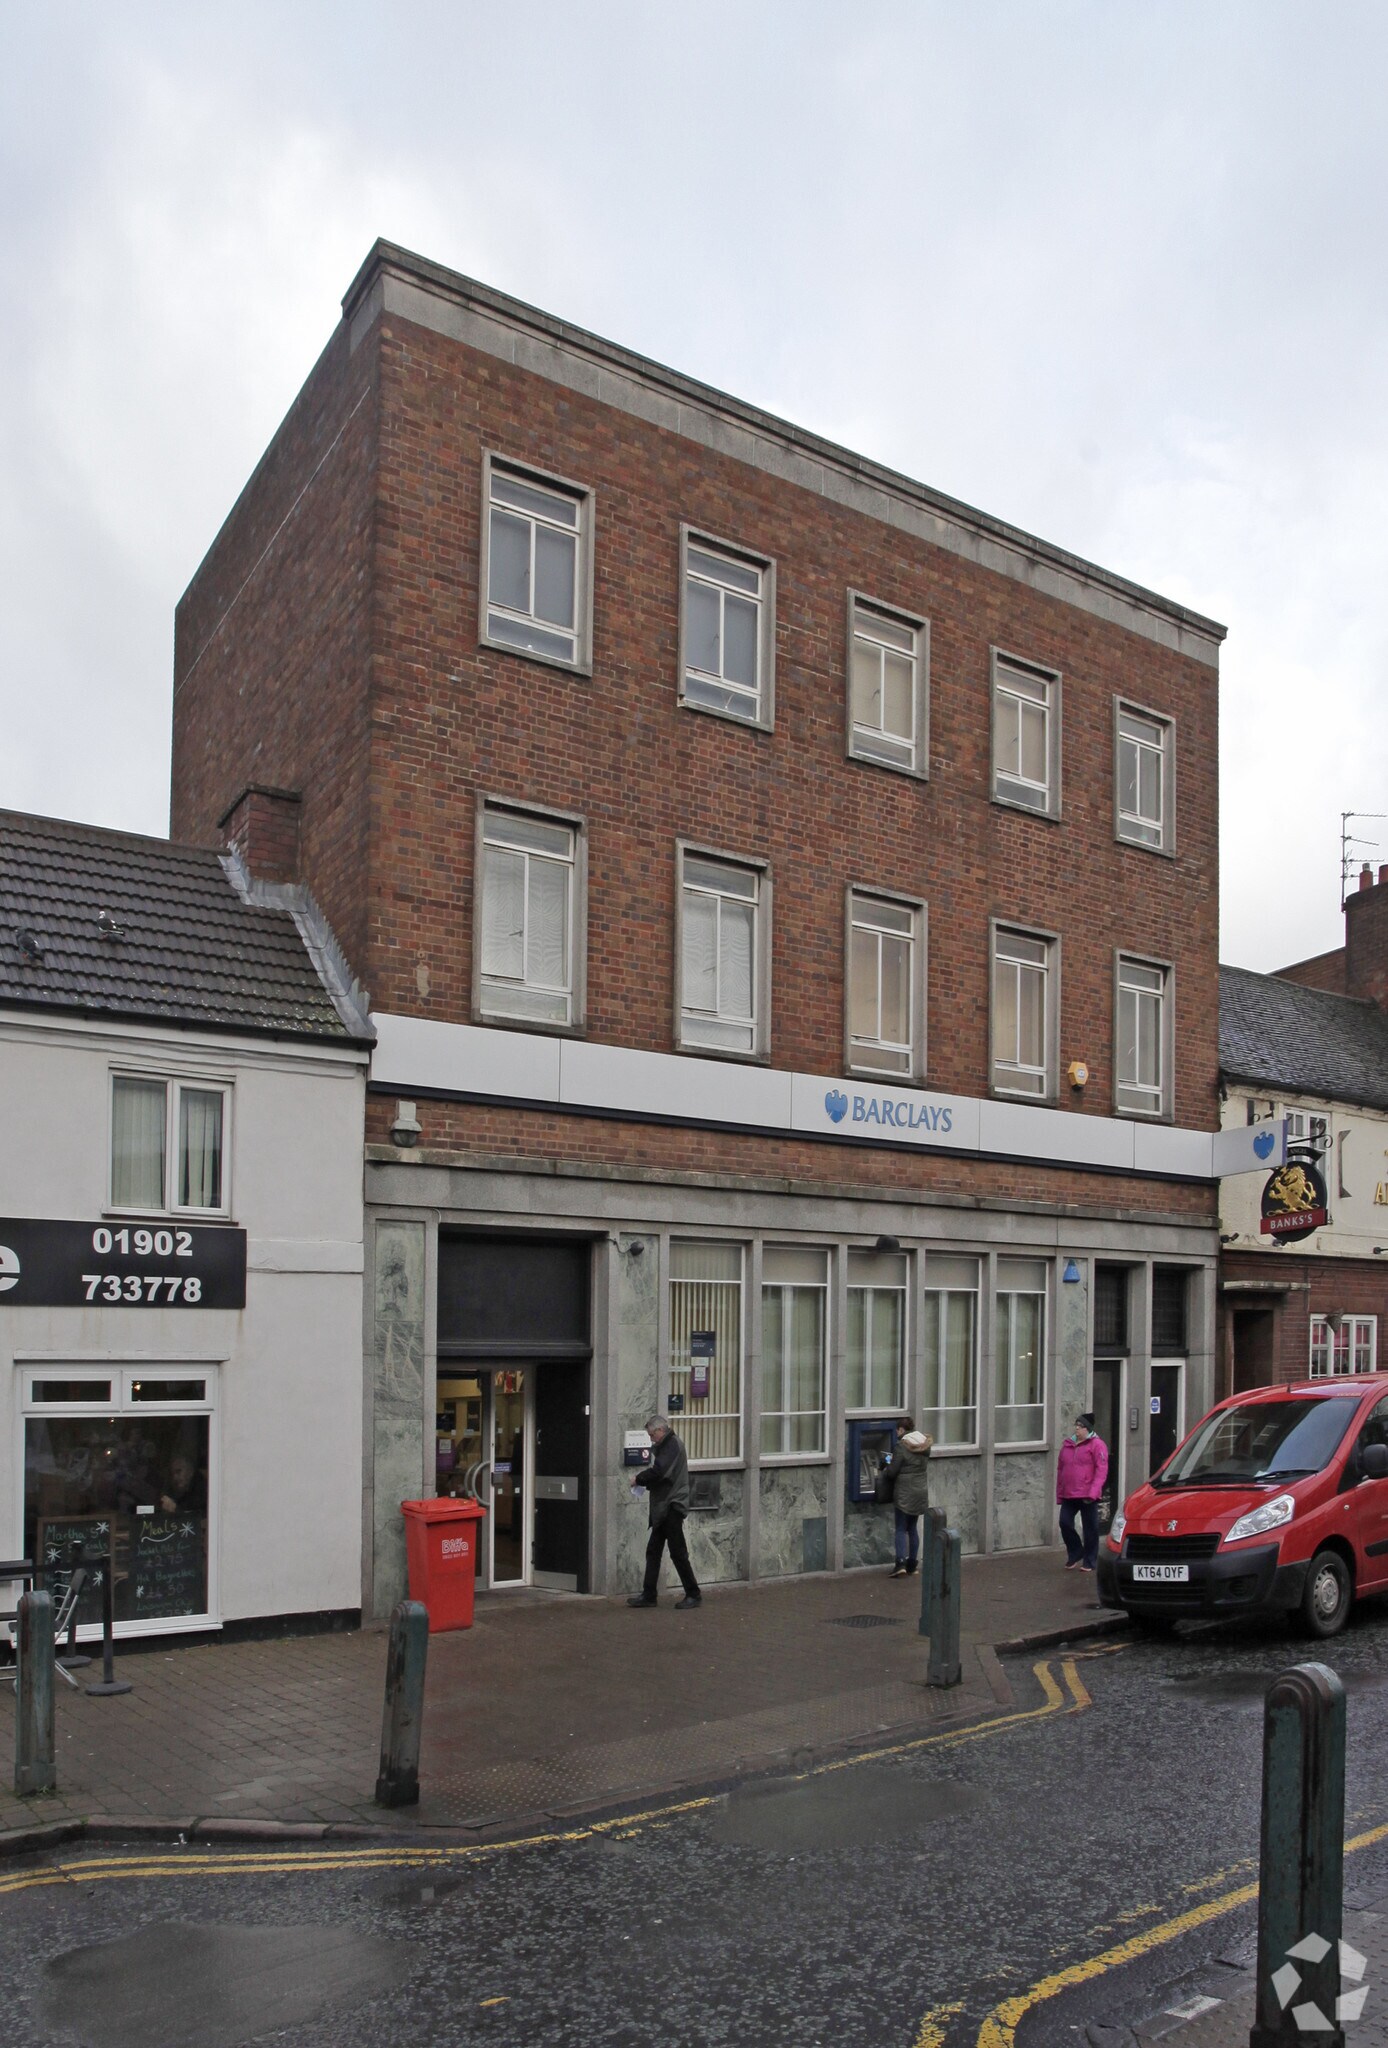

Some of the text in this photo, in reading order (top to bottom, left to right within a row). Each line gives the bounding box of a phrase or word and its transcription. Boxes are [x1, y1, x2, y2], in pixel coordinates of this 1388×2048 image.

[852, 1096, 953, 1132] BARCLAYS
[1270, 1214, 1313, 1230] BANKS'S
[92, 1228, 193, 1257] 01902
[81, 1274, 202, 1303] 733778
[1137, 1566, 1184, 1578] KT64 OYF
